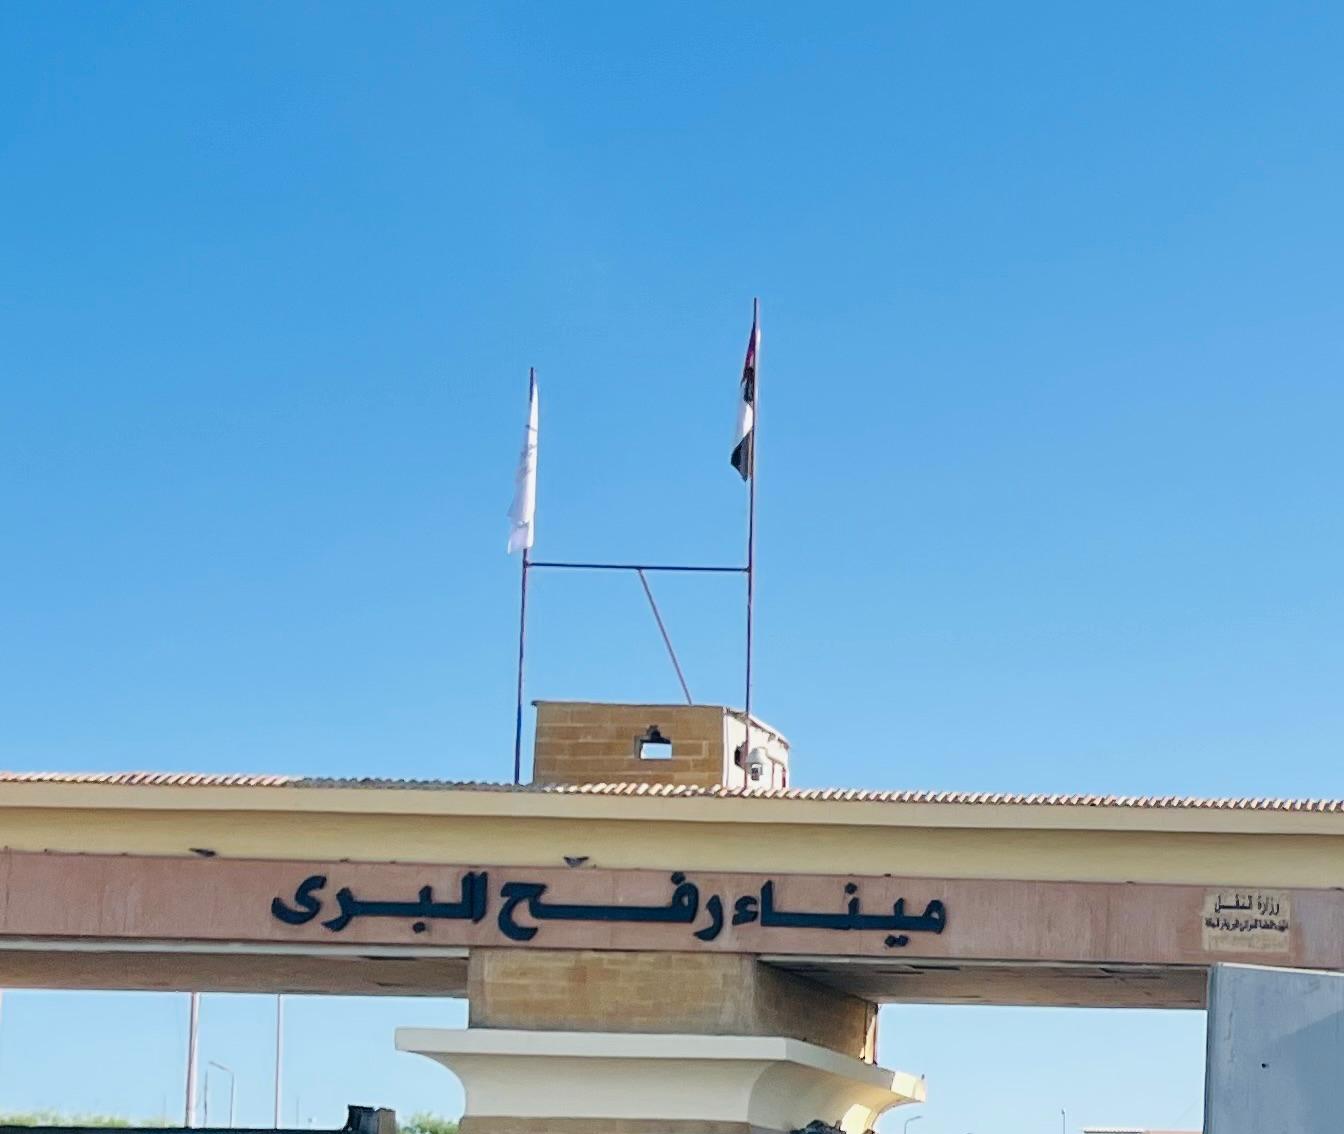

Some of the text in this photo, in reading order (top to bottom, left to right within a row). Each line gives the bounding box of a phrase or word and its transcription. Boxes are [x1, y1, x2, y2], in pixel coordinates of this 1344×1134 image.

[270, 870, 946, 947] ميناء رفح البرى
